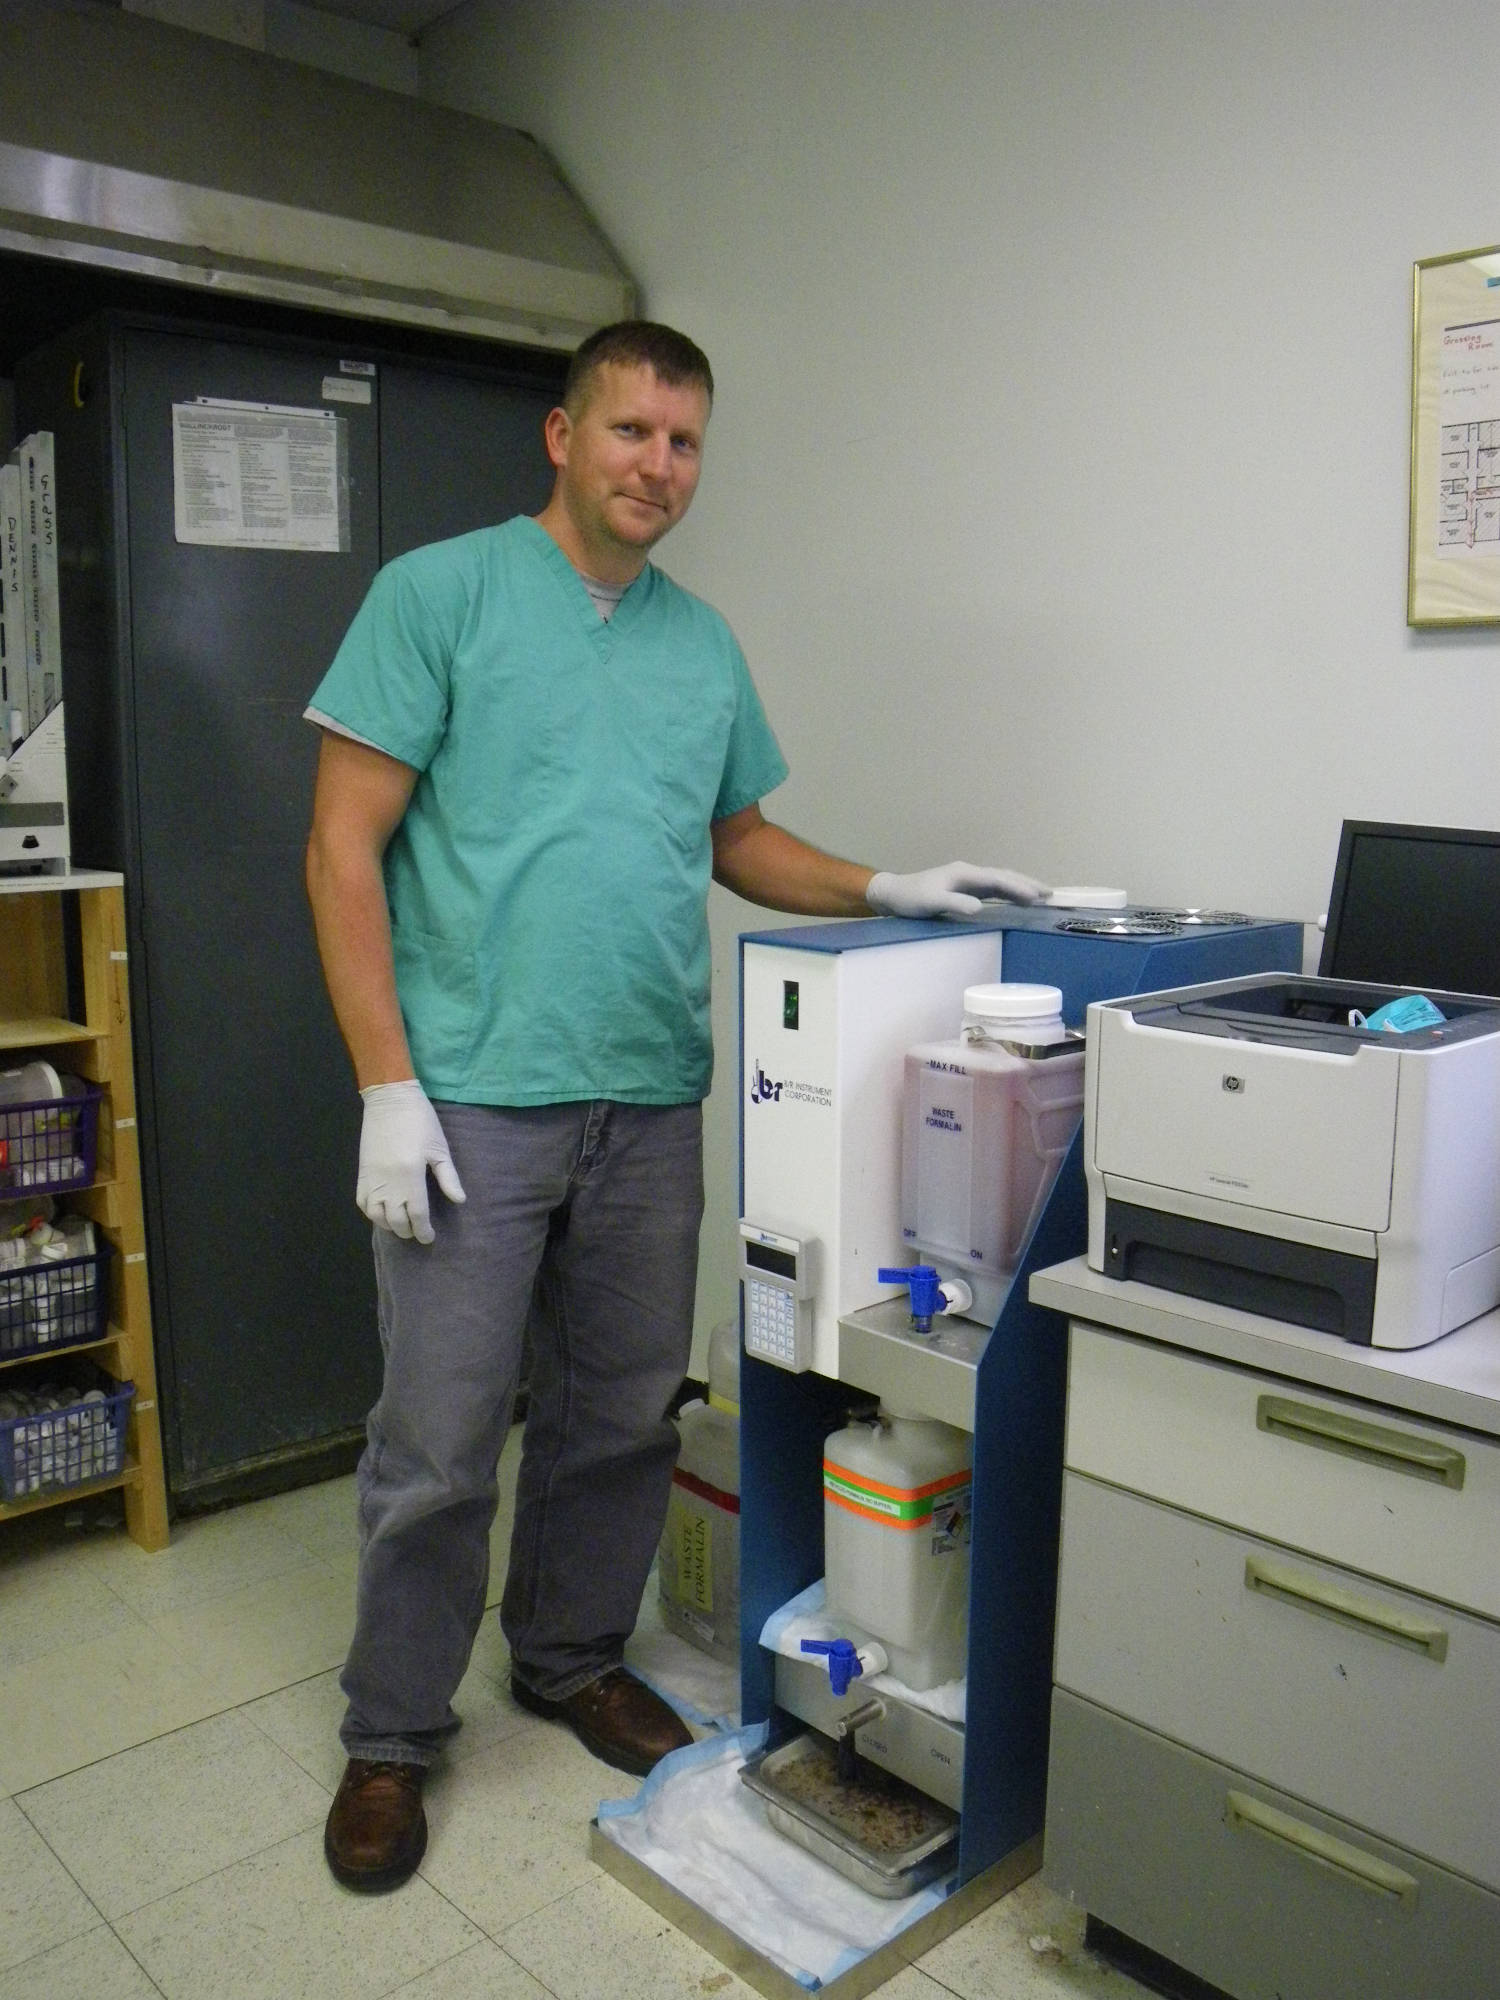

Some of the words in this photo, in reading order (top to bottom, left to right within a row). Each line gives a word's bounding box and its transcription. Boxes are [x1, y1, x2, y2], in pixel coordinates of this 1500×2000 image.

[949, 1064, 967, 1075] FILL
[784, 1090, 832, 1107] CORPORATION
[932, 1107, 956, 1119] WASTE
[925, 1117, 962, 1132] FORMALIN
[970, 1249, 983, 1260] ON
[683, 1527, 692, 1580] WASTE
[695, 1518, 705, 1604] FORMALIN
